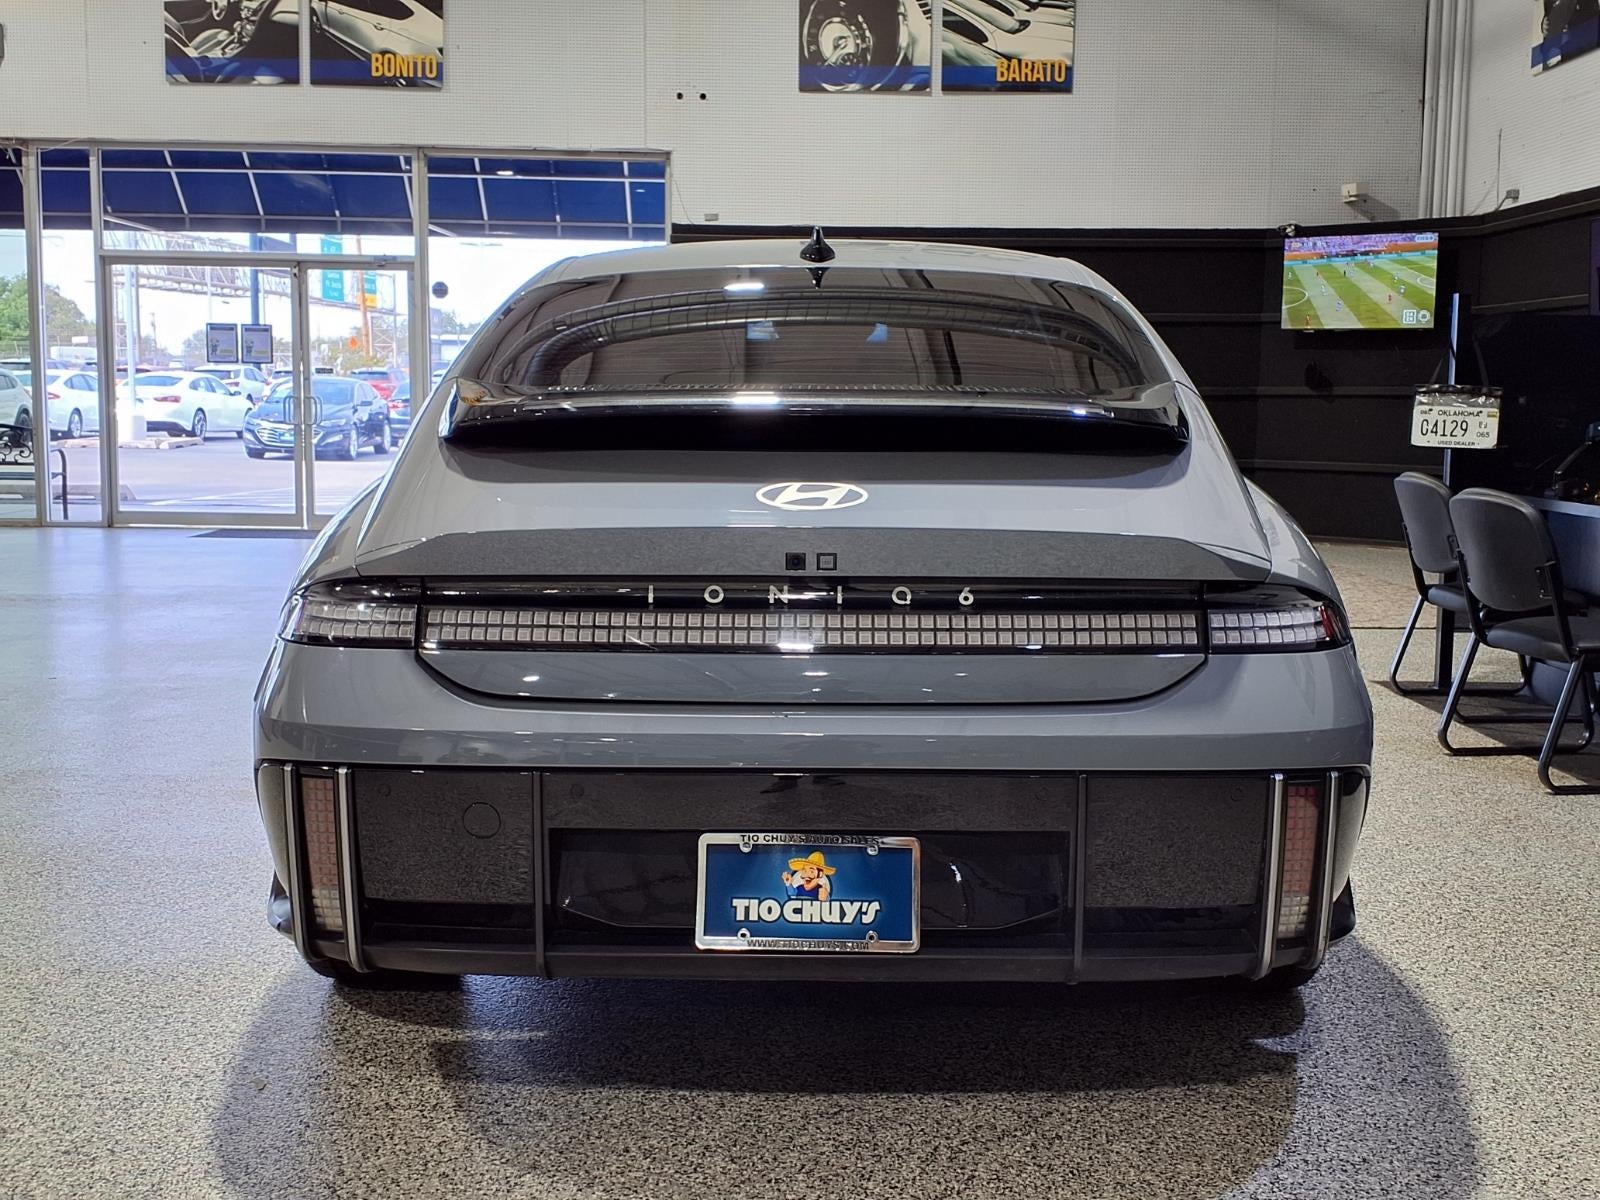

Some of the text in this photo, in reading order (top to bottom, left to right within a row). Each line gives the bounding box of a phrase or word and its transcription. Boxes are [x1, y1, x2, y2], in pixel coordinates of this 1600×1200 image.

[371, 52, 438, 78] BONITO
[996, 58, 1067, 82] BARATO
[1437, 409, 1480, 417] OKLAHOMA
[740, 834, 881, 846] TIO CHUY'S AUTO SALES
